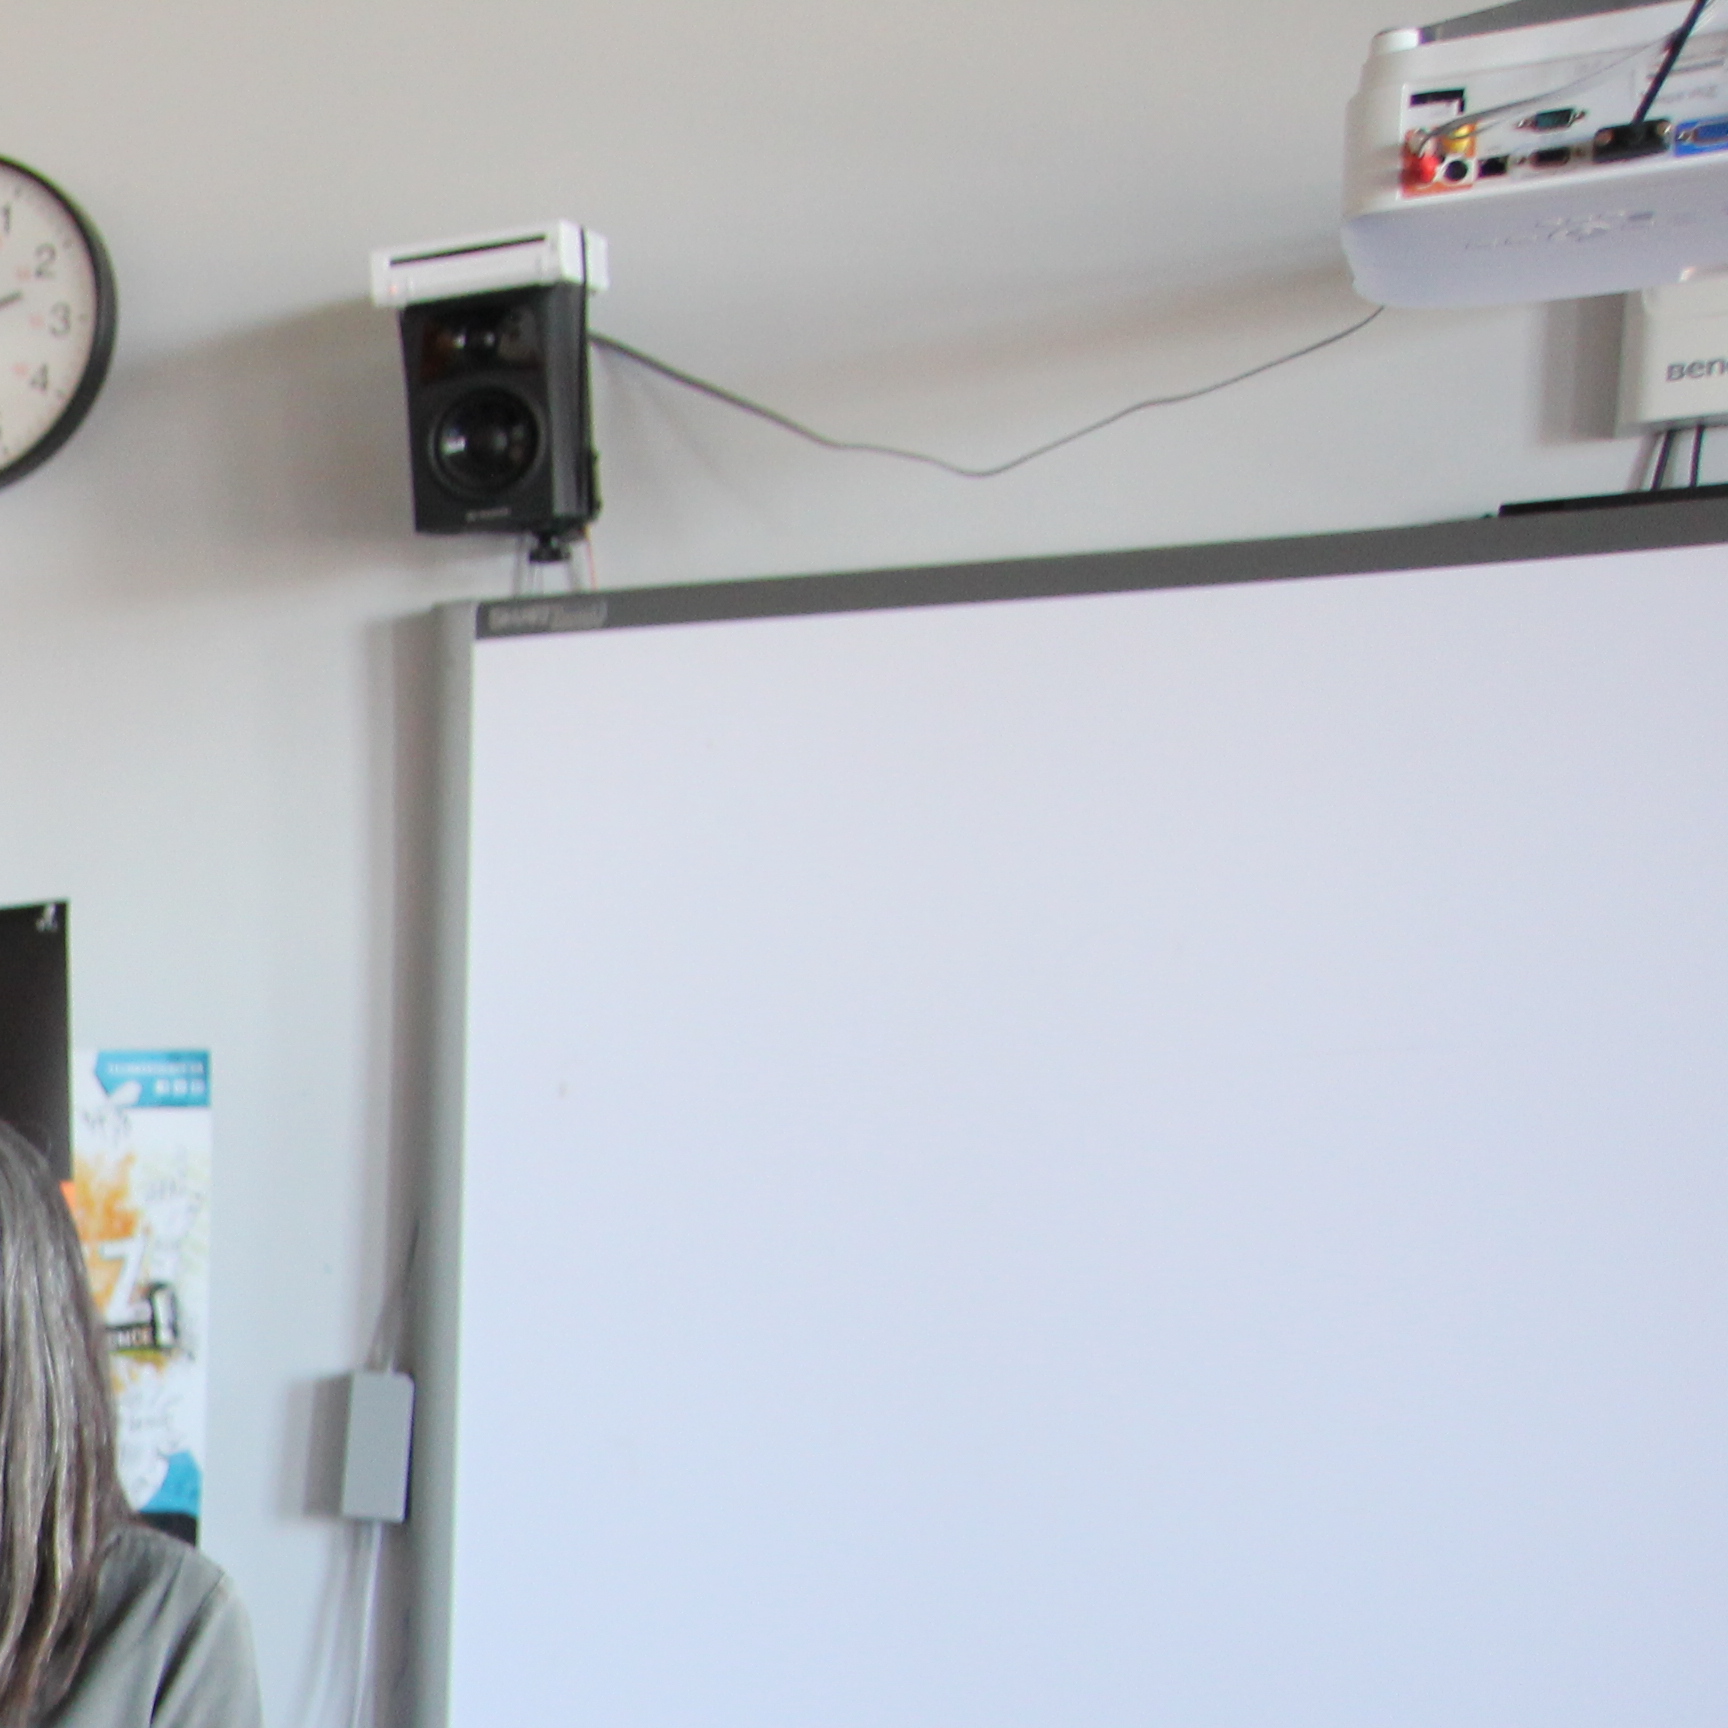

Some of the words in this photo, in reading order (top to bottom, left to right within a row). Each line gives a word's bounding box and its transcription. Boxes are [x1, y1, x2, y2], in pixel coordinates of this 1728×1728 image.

[0, 201, 13, 236] 1
[34, 243, 57, 279] 2
[49, 301, 71, 337] 3
[30, 362, 49, 396] 4
[1665, 359, 1728, 383] Ben
